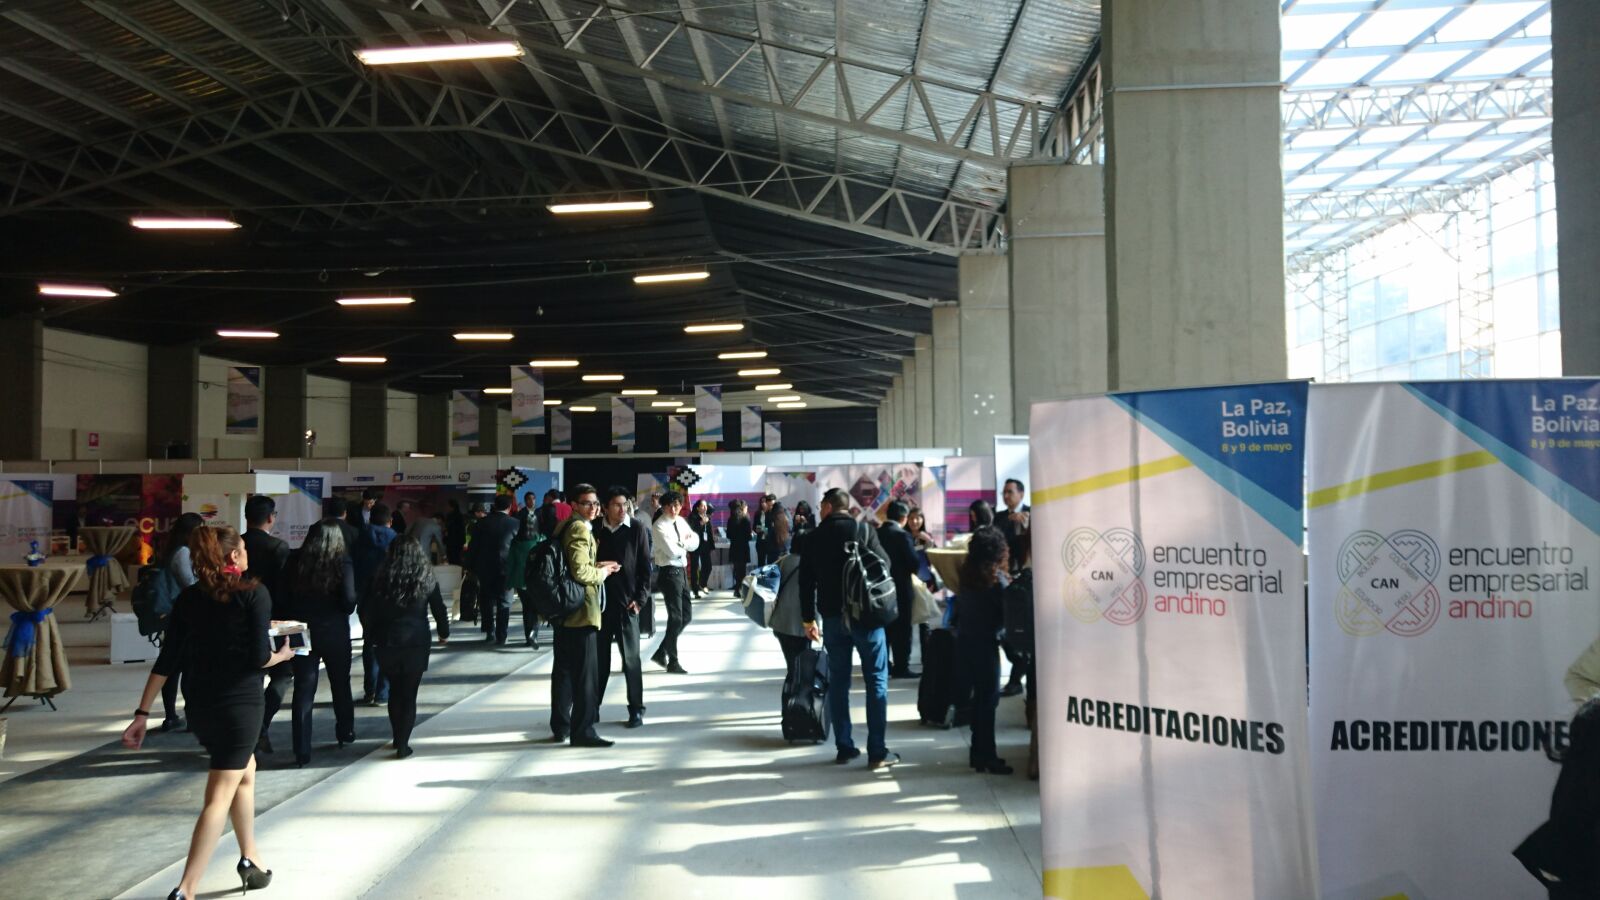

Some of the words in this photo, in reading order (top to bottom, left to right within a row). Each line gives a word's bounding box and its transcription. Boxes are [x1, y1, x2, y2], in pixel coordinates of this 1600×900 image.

[1221, 400, 1245, 417] La
[1250, 399, 1292, 417] Paz,
[1531, 394, 1556, 412] La
[1222, 419, 1289, 438] Bolivia
[1531, 415, 1600, 433] Bolivia
[1221, 443, 1229, 453] 8
[1231, 445, 1237, 455] y
[1239, 443, 1246, 452] 9
[1248, 443, 1261, 452] de
[1263, 443, 1293, 454] mayo
[1557, 438, 1570, 449] de
[1153, 543, 1267, 567] encuentro
[1449, 541, 1574, 566] encuentro
[1091, 571, 1114, 581] CAN
[1153, 569, 1283, 595] empresarial
[1371, 578, 1399, 589] CAN
[1449, 567, 1589, 597] empresarial
[1154, 592, 1227, 616] andino
[1449, 593, 1533, 619] andino
[1067, 696, 1286, 755] ACREDITACIONES
[1330, 719, 1570, 752] ACREDITACIONE
